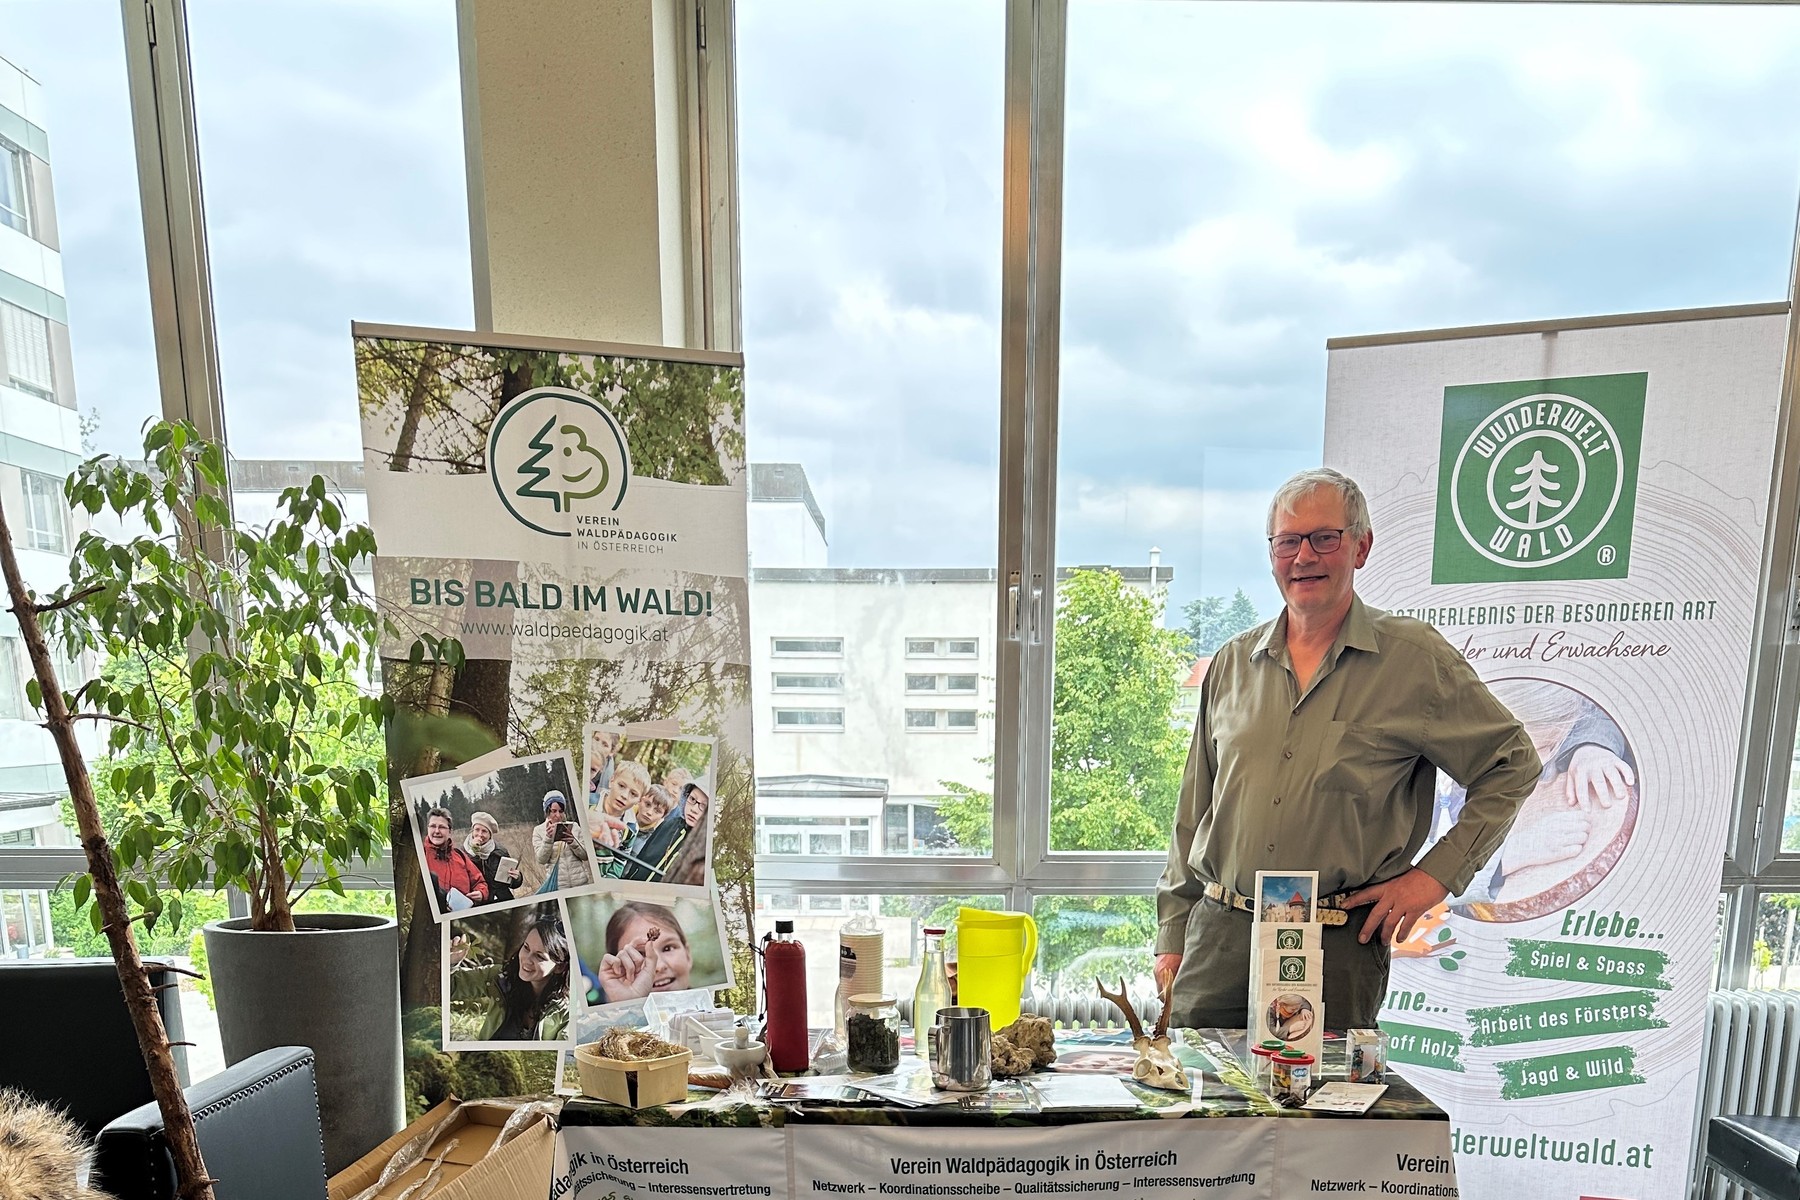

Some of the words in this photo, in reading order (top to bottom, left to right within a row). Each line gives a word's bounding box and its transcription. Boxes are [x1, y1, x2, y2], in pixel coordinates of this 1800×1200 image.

[1473, 403, 1610, 458] WUNDERWELT
[577, 516, 620, 526] VEREIN
[577, 528, 678, 542] WALDPÄDAGOGIK
[578, 542, 590, 550] IN
[593, 540, 664, 554] ÖSTERREICH
[1488, 524, 1574, 559] WALD
[410, 578, 465, 606] BIS
[475, 580, 561, 610] BALD
[573, 584, 606, 613] IM
[616, 587, 713, 617] WALD!
[1524, 604, 1554, 624] DER
[1563, 602, 1674, 623] BESONDEREN
[1682, 600, 1717, 620] ART
[460, 620, 669, 645] www.waldpaedagogik.at
[1493, 633, 1540, 661] und
[1542, 630, 1672, 662] Erwachsene
[1560, 909, 1664, 939] Erlebe...
[1530, 950, 1571, 970] Spiel
[1576, 958, 1590, 970] &
[1596, 956, 1646, 976] Spass
[1480, 1013, 1533, 1035] Arbeit
[1538, 1010, 1568, 1026] des
[1574, 1002, 1648, 1024] Försters
[1420, 1036, 1456, 1058] Holz
[1520, 1066, 1558, 1087] Jagd
[1566, 1066, 1580, 1080] &
[1585, 1057, 1624, 1078] Wild
[590, 1151, 604, 1166] in
[608, 1154, 689, 1175] Österreich
[890, 1158, 942, 1175] Verein
[946, 1154, 1070, 1176] Waldpädagogik
[1075, 1154, 1090, 1171] in
[1094, 1150, 1178, 1171] Österreich
[1396, 1153, 1450, 1174] Verein
[648, 1182, 771, 1196] Interessensvertretung
[812, 1180, 866, 1194] Netzwerk
[879, 1182, 1001, 1196] Koordinationsscheibe
[1014, 1178, 1120, 1196] Qualitätssicherung
[1133, 1170, 1256, 1189] Interessensvertretung
[1310, 1179, 1366, 1192] Netzwerk
[1381, 1180, 1460, 1198] Koordinations
